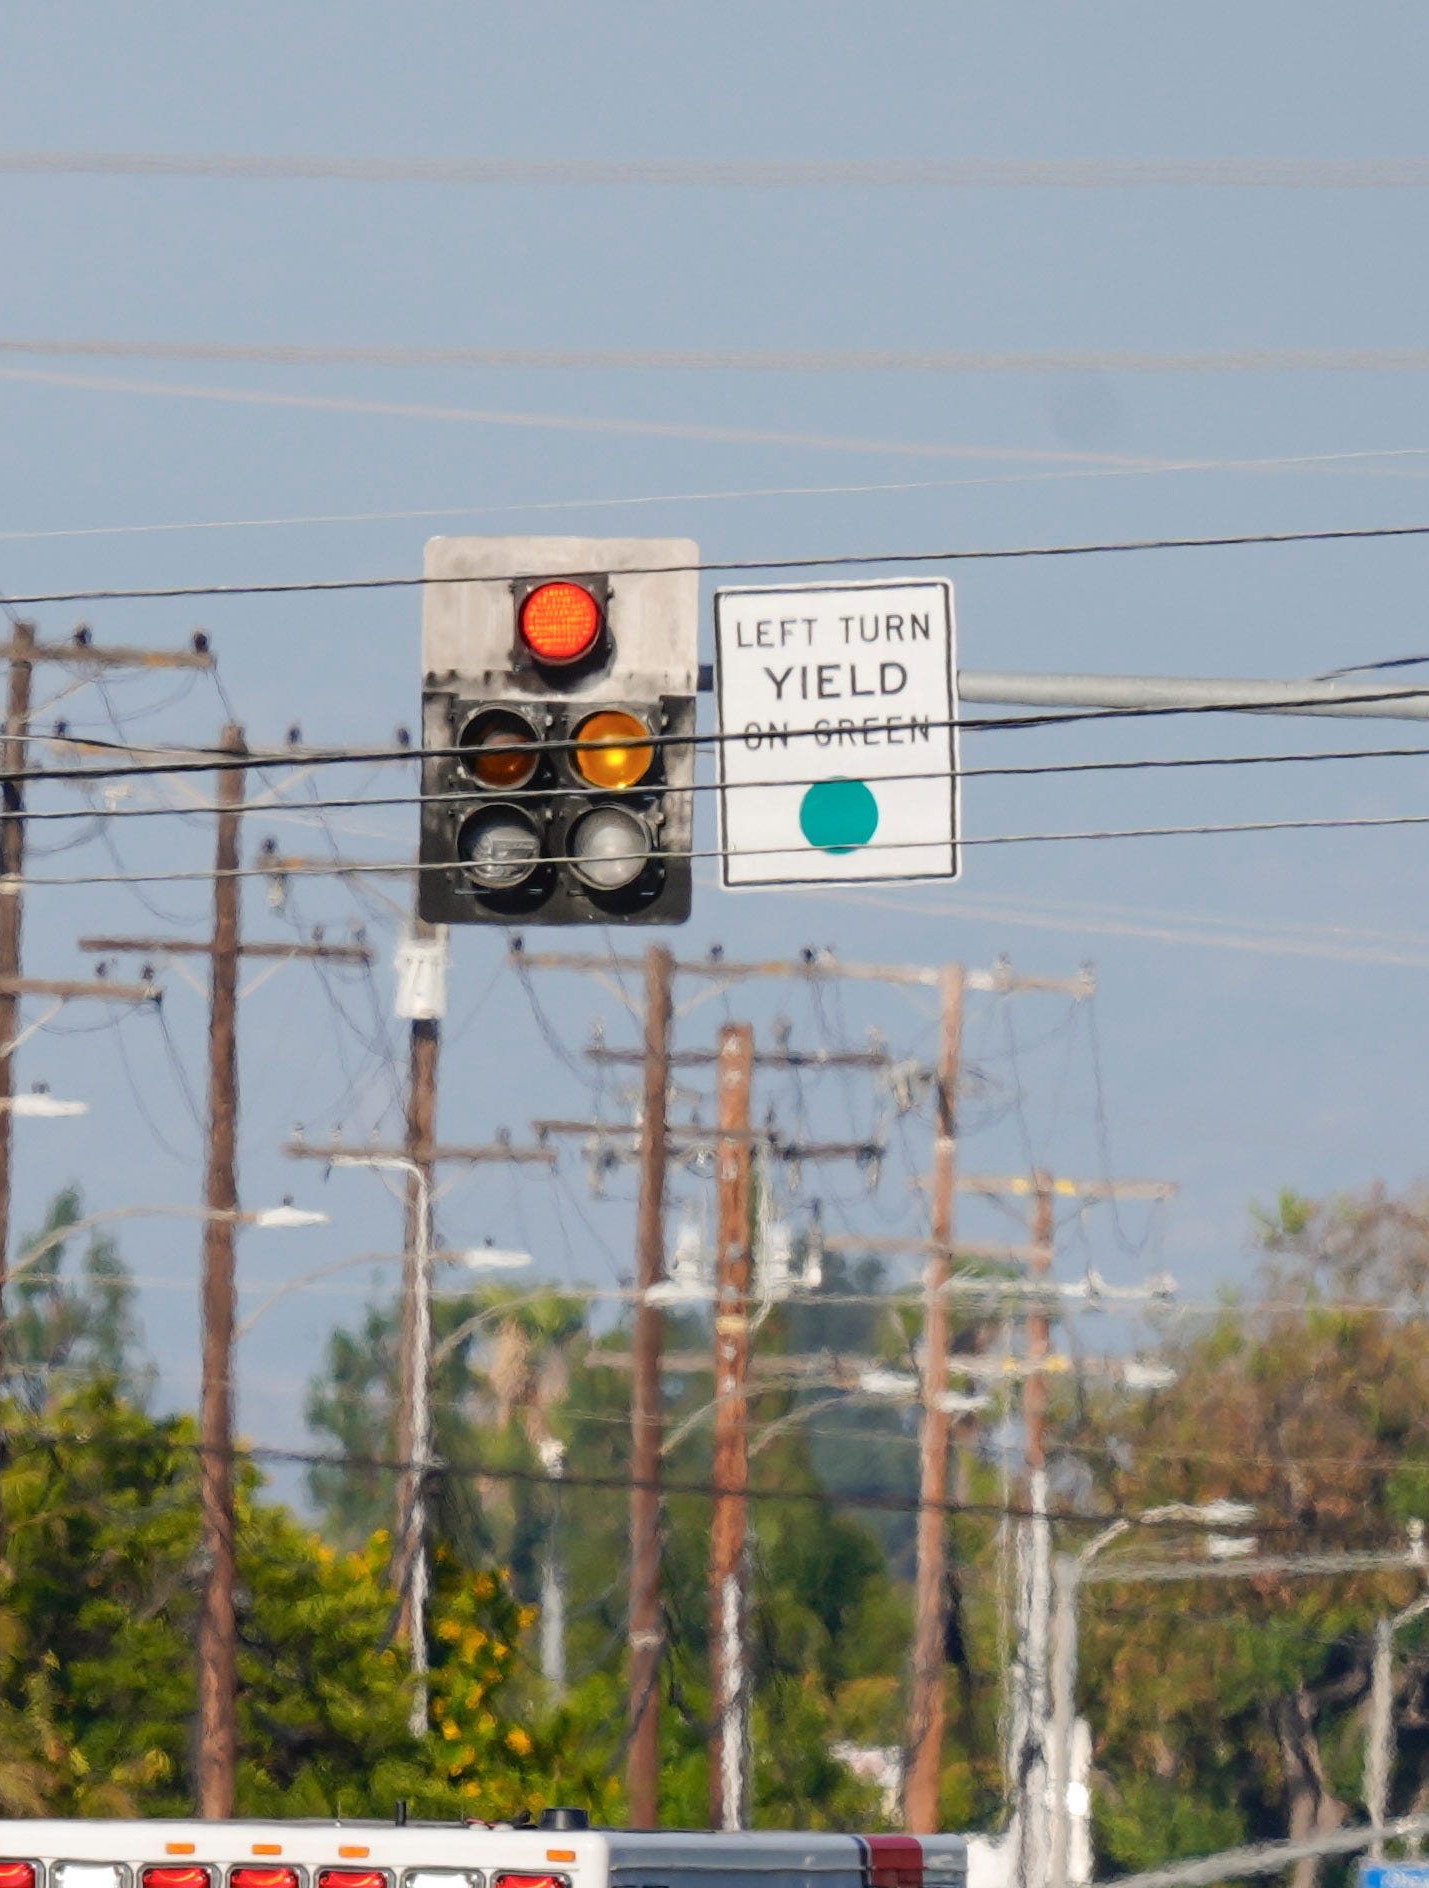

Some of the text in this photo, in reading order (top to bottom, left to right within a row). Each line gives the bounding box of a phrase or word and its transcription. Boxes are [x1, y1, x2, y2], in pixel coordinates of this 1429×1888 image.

[737, 614, 931, 648] LEFT TURN
[763, 662, 908, 700] YIELD
[744, 715, 931, 751] ON GREEN
